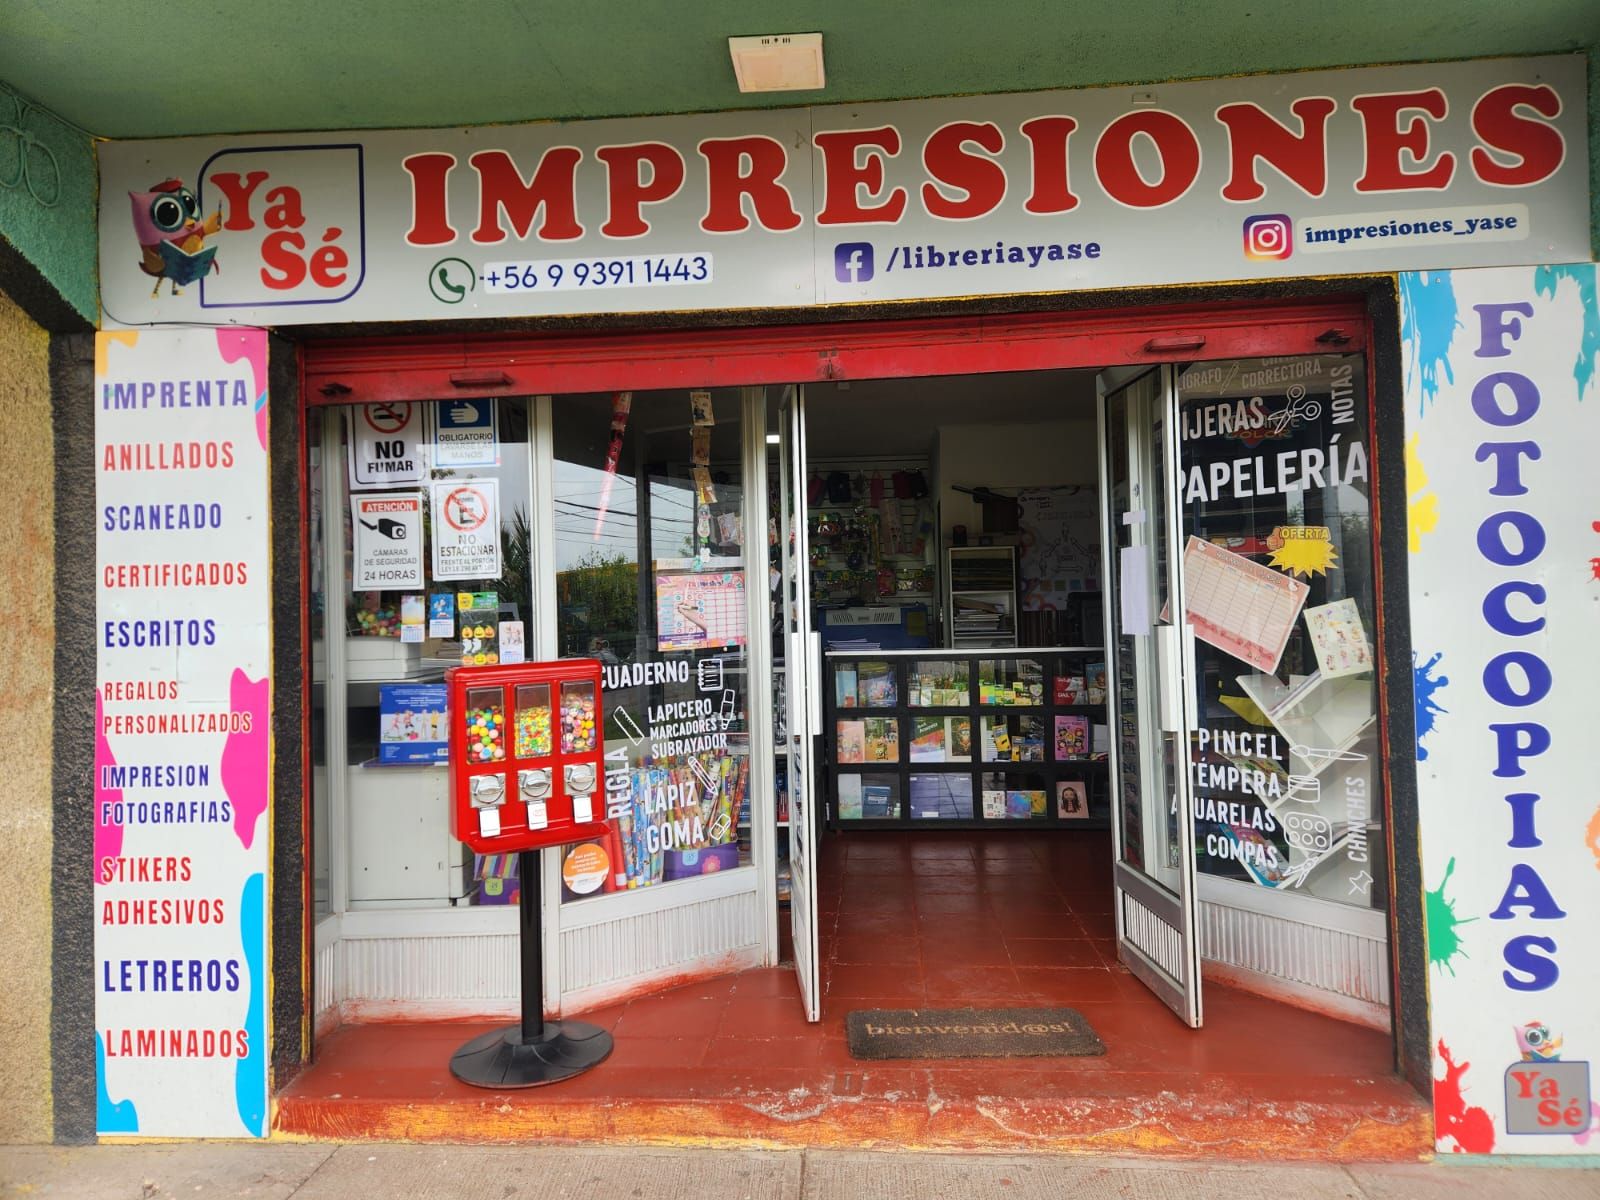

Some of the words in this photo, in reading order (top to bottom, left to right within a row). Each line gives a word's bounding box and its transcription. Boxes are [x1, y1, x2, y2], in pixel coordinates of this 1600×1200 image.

[401, 83, 1566, 247] IMPRESIONES
[210, 171, 306, 232] Ya
[1305, 215, 1518, 244] impresiones_yase
[260, 228, 349, 291] Sé
[885, 241, 1101, 273] /libreriayase
[487, 265, 538, 288] +56
[547, 264, 563, 287] 9
[573, 260, 634, 286] 9391
[643, 256, 708, 283] 1443
[1179, 367, 1222, 391] IGRAFO
[1242, 359, 1322, 389] CORRECTORA
[103, 379, 248, 410] IMPRENTA
[1331, 365, 1354, 425] NOTAS
[1182, 396, 1264, 441] IJERAS
[375, 440, 405, 459] NO
[439, 432, 493, 442] OBLIGATORIO
[104, 441, 234, 471] ANILLADOS
[367, 460, 414, 474] FUMAR
[104, 503, 222, 531] SCANEADO
[366, 500, 413, 512] ATENCIÓN
[458, 534, 476, 545] NO
[1281, 527, 1330, 539] OFERTA
[376, 557, 417, 566] SEGURIDAD
[440, 545, 494, 557] ESTACIONAR
[104, 562, 248, 588] CERTIFICADOS
[364, 571, 376, 581] 24
[379, 570, 416, 580] HORAS
[105, 619, 216, 647] ESCRITOS
[1471, 301, 1567, 993] FOTOCOPIAS
[104, 681, 178, 702] REGALOS
[103, 712, 252, 734] PERSONALIZADOS
[648, 698, 713, 723] LAPICERO
[650, 717, 717, 741] MARCADORES
[651, 733, 728, 759] SUBRAYADOR
[1198, 727, 1282, 761] PINCEL
[102, 764, 209, 788] IMPRESION
[606, 746, 633, 819] REGLA
[644, 780, 697, 814] LÁPIZ
[102, 801, 231, 825] FOTOGRAFIAS
[1345, 776, 1368, 862] CHINCHES
[646, 816, 704, 853] GOMA
[1207, 834, 1279, 869] COMPAS
[102, 856, 192, 882] STIKERS
[102, 899, 224, 925] ADHESIVOS
[104, 959, 240, 992] LETREROS
[106, 1030, 249, 1057] LAMINADOS
[1510, 1071, 1559, 1099] Ya
[1537, 1097, 1583, 1127] Sé
